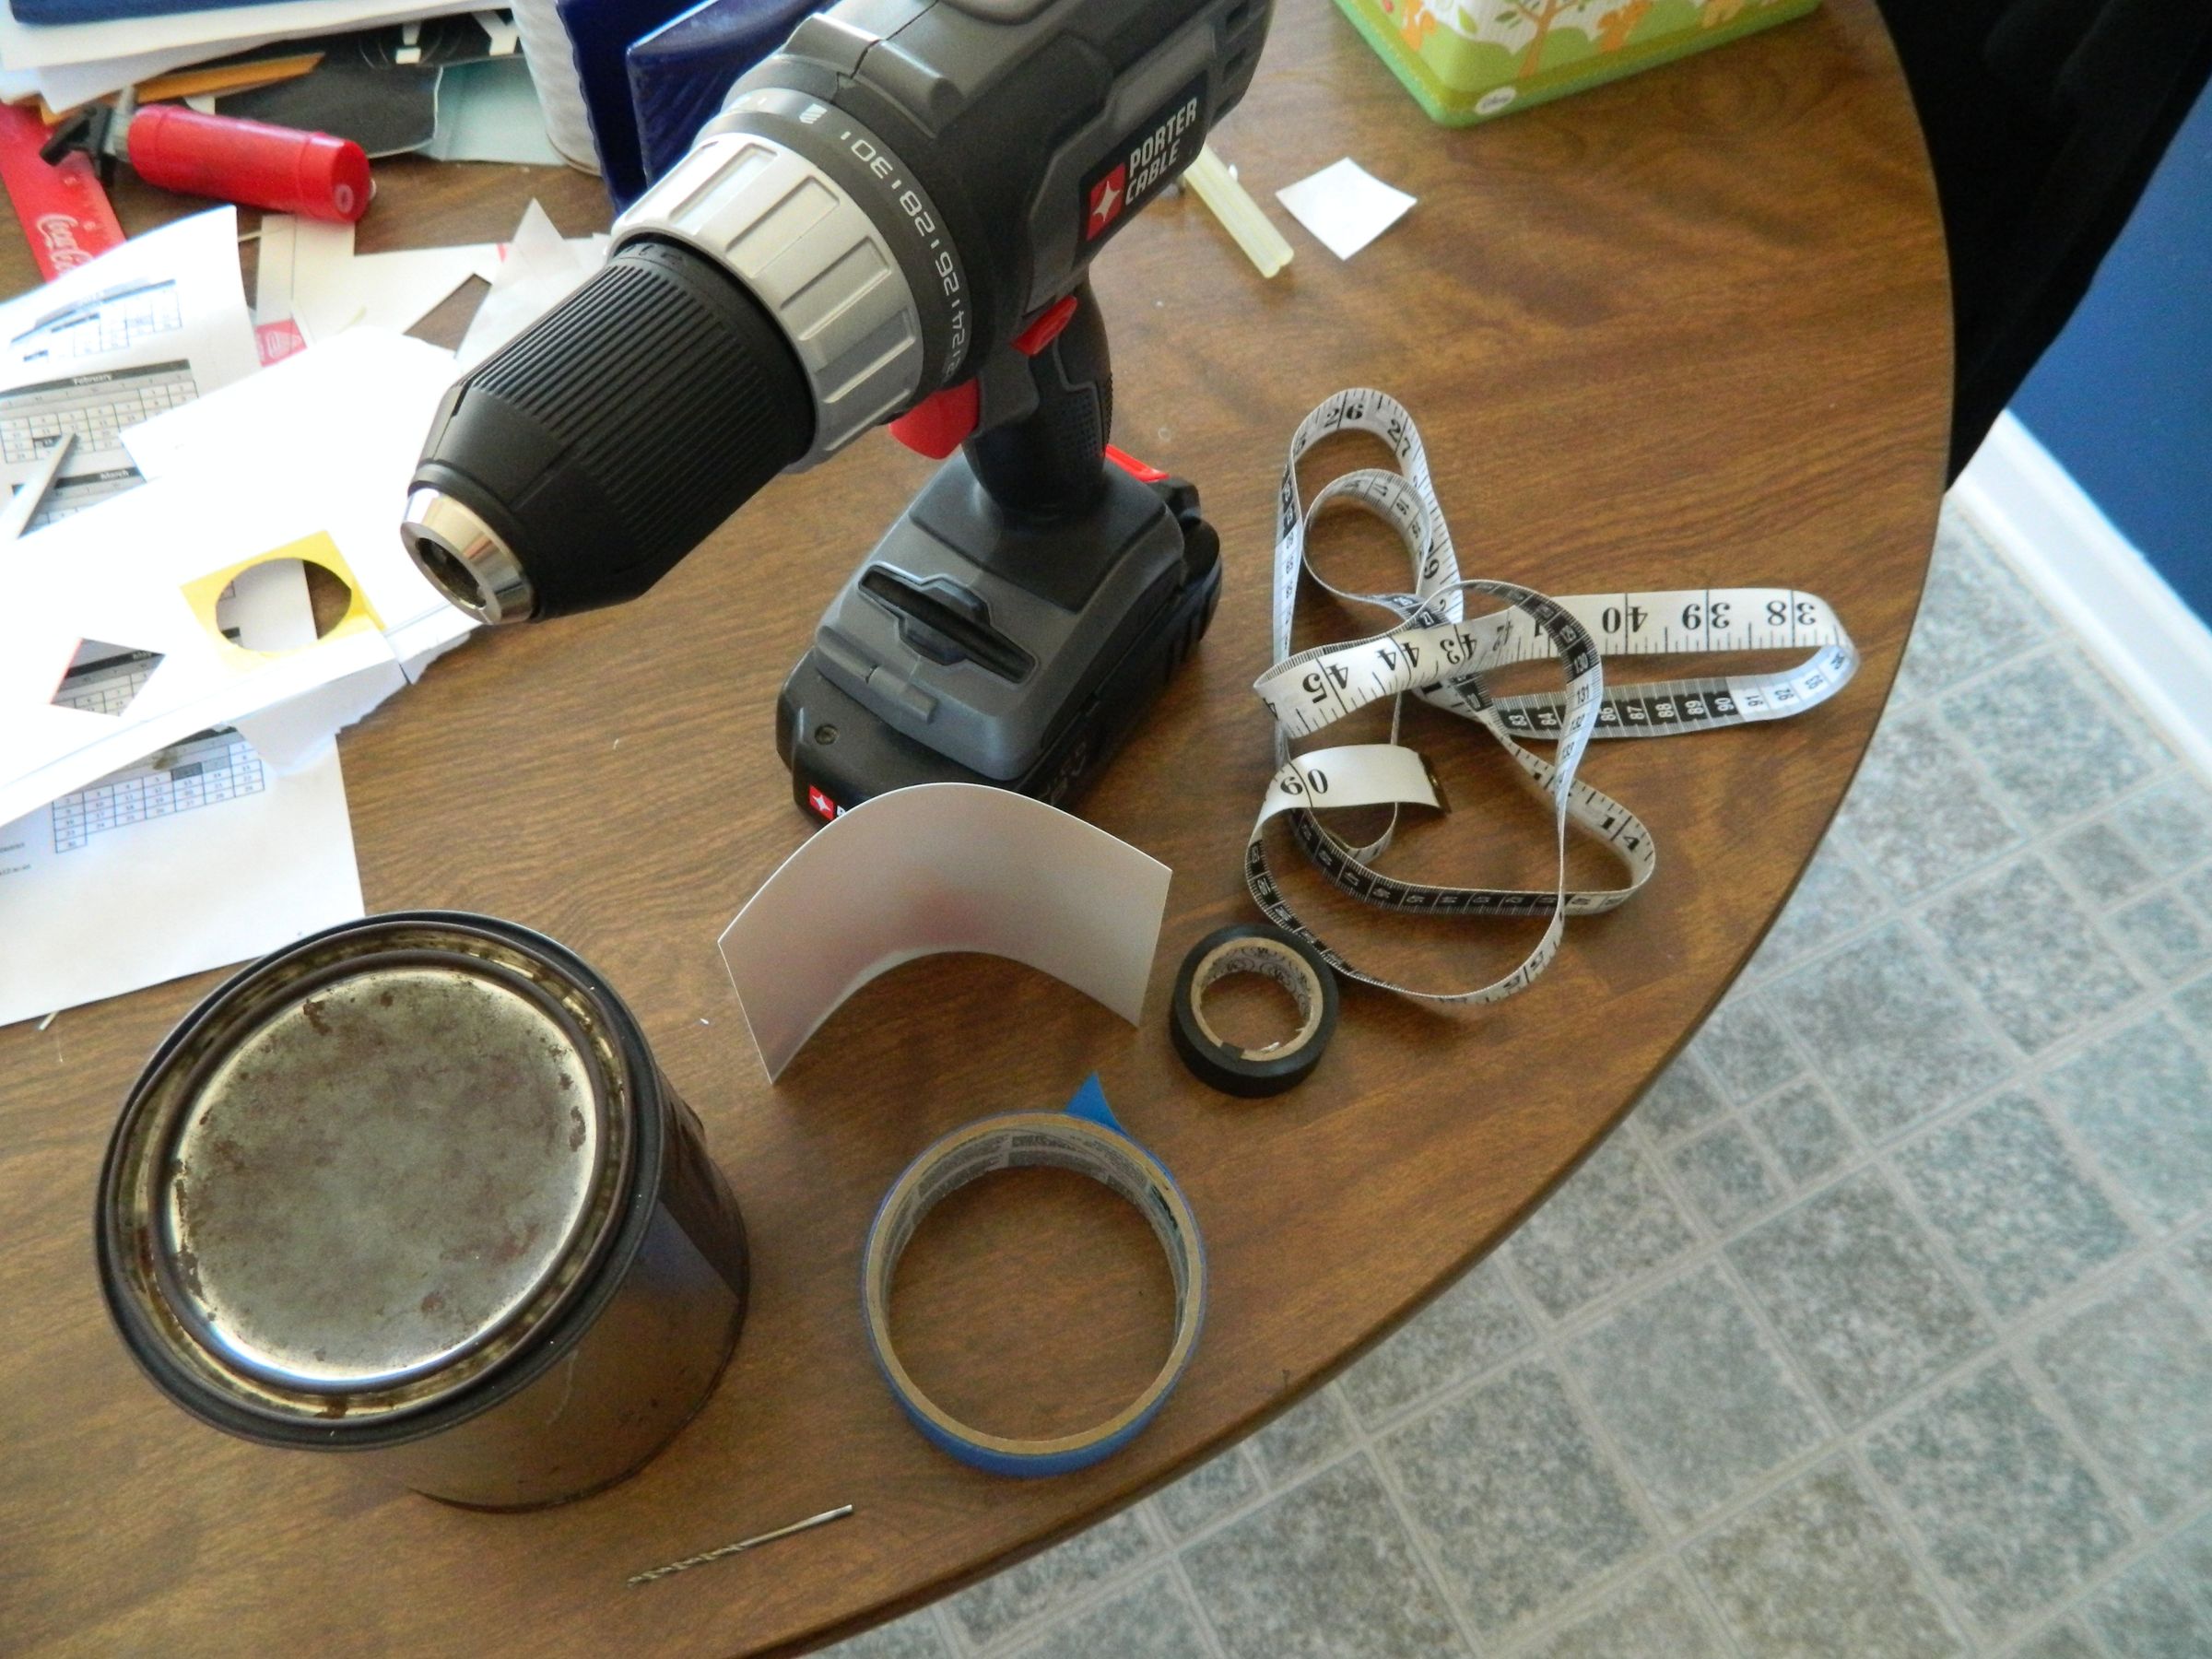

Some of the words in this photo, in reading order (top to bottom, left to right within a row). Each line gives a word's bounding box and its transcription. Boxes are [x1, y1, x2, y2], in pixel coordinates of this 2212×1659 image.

[1130, 97, 1197, 178] PORTER
[851, 138, 893, 180] 30
[1124, 139, 1181, 206] CABLE
[899, 190, 935, 238] 28
[935, 251, 959, 297] 26
[1324, 403, 1364, 428] 26
[1387, 418, 1412, 457] 27
[1603, 606, 1648, 633] 40
[1682, 602, 1731, 630] 39
[1767, 600, 1817, 626] 38
[1375, 641, 1419, 671] 44
[1439, 633, 1477, 665] 43
[1302, 664, 1348, 704] 45
[1627, 705, 1645, 721] 87
[1655, 702, 1676, 720] 88
[1685, 700, 1705, 715] 89
[1713, 697, 1735, 712] 90
[1537, 712, 1558, 727] 84
[1280, 769, 1329, 795] 60
